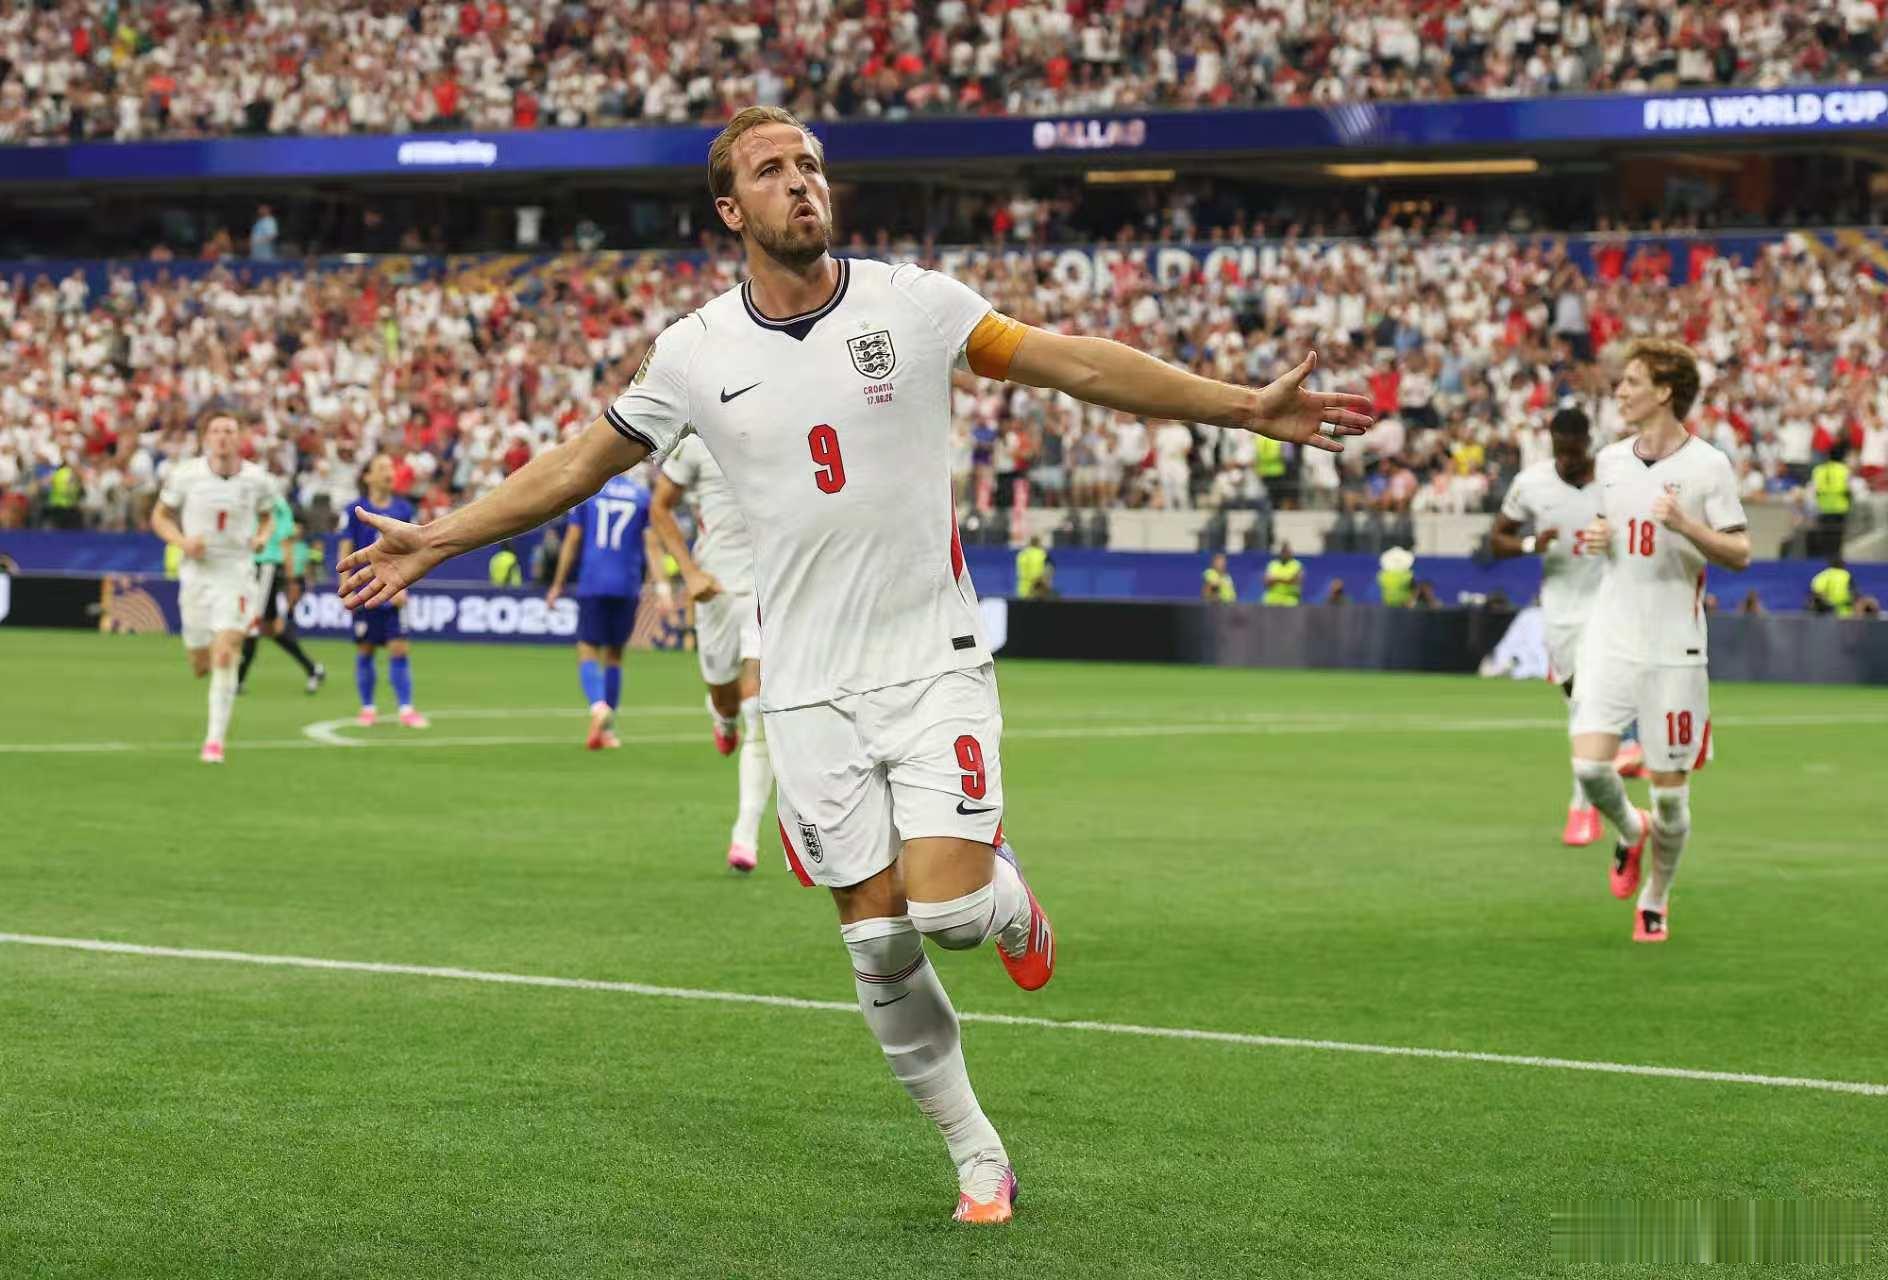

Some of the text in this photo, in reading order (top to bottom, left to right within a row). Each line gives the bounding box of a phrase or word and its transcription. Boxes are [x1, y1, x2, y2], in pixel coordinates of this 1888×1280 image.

[1643, 90, 1888, 130] FIFA WORLD CUP
[863, 382, 895, 395] CROATIA
[807, 424, 847, 494] 9
[595, 498, 636, 550] 17
[1627, 517, 1656, 557] 18
[1665, 709, 1693, 747] 18
[953, 734, 986, 800] 9
